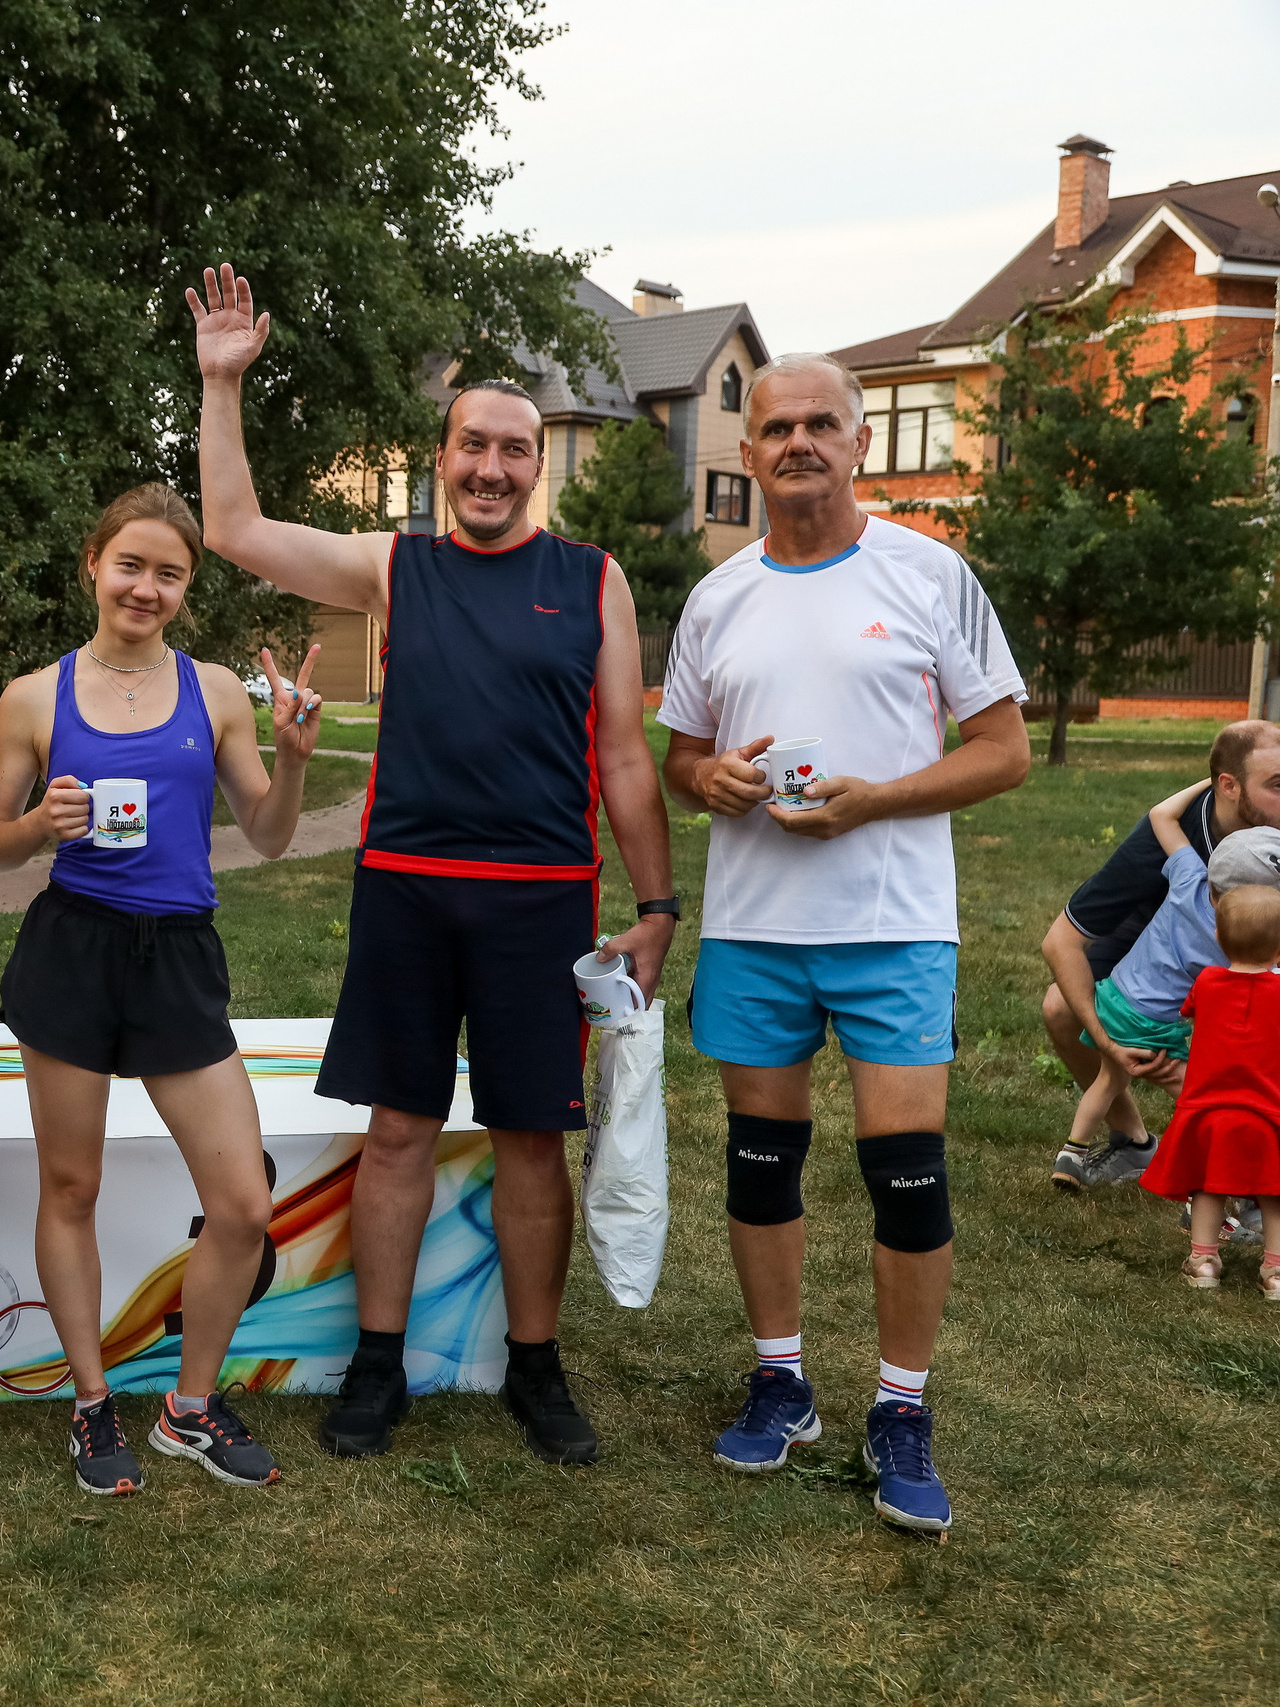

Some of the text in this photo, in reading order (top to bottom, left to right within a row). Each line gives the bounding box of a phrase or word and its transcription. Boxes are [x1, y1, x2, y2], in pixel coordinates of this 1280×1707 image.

[860, 632, 891, 640] adidas
[784, 769, 795, 781] Я
[109, 805, 119, 817] Я
